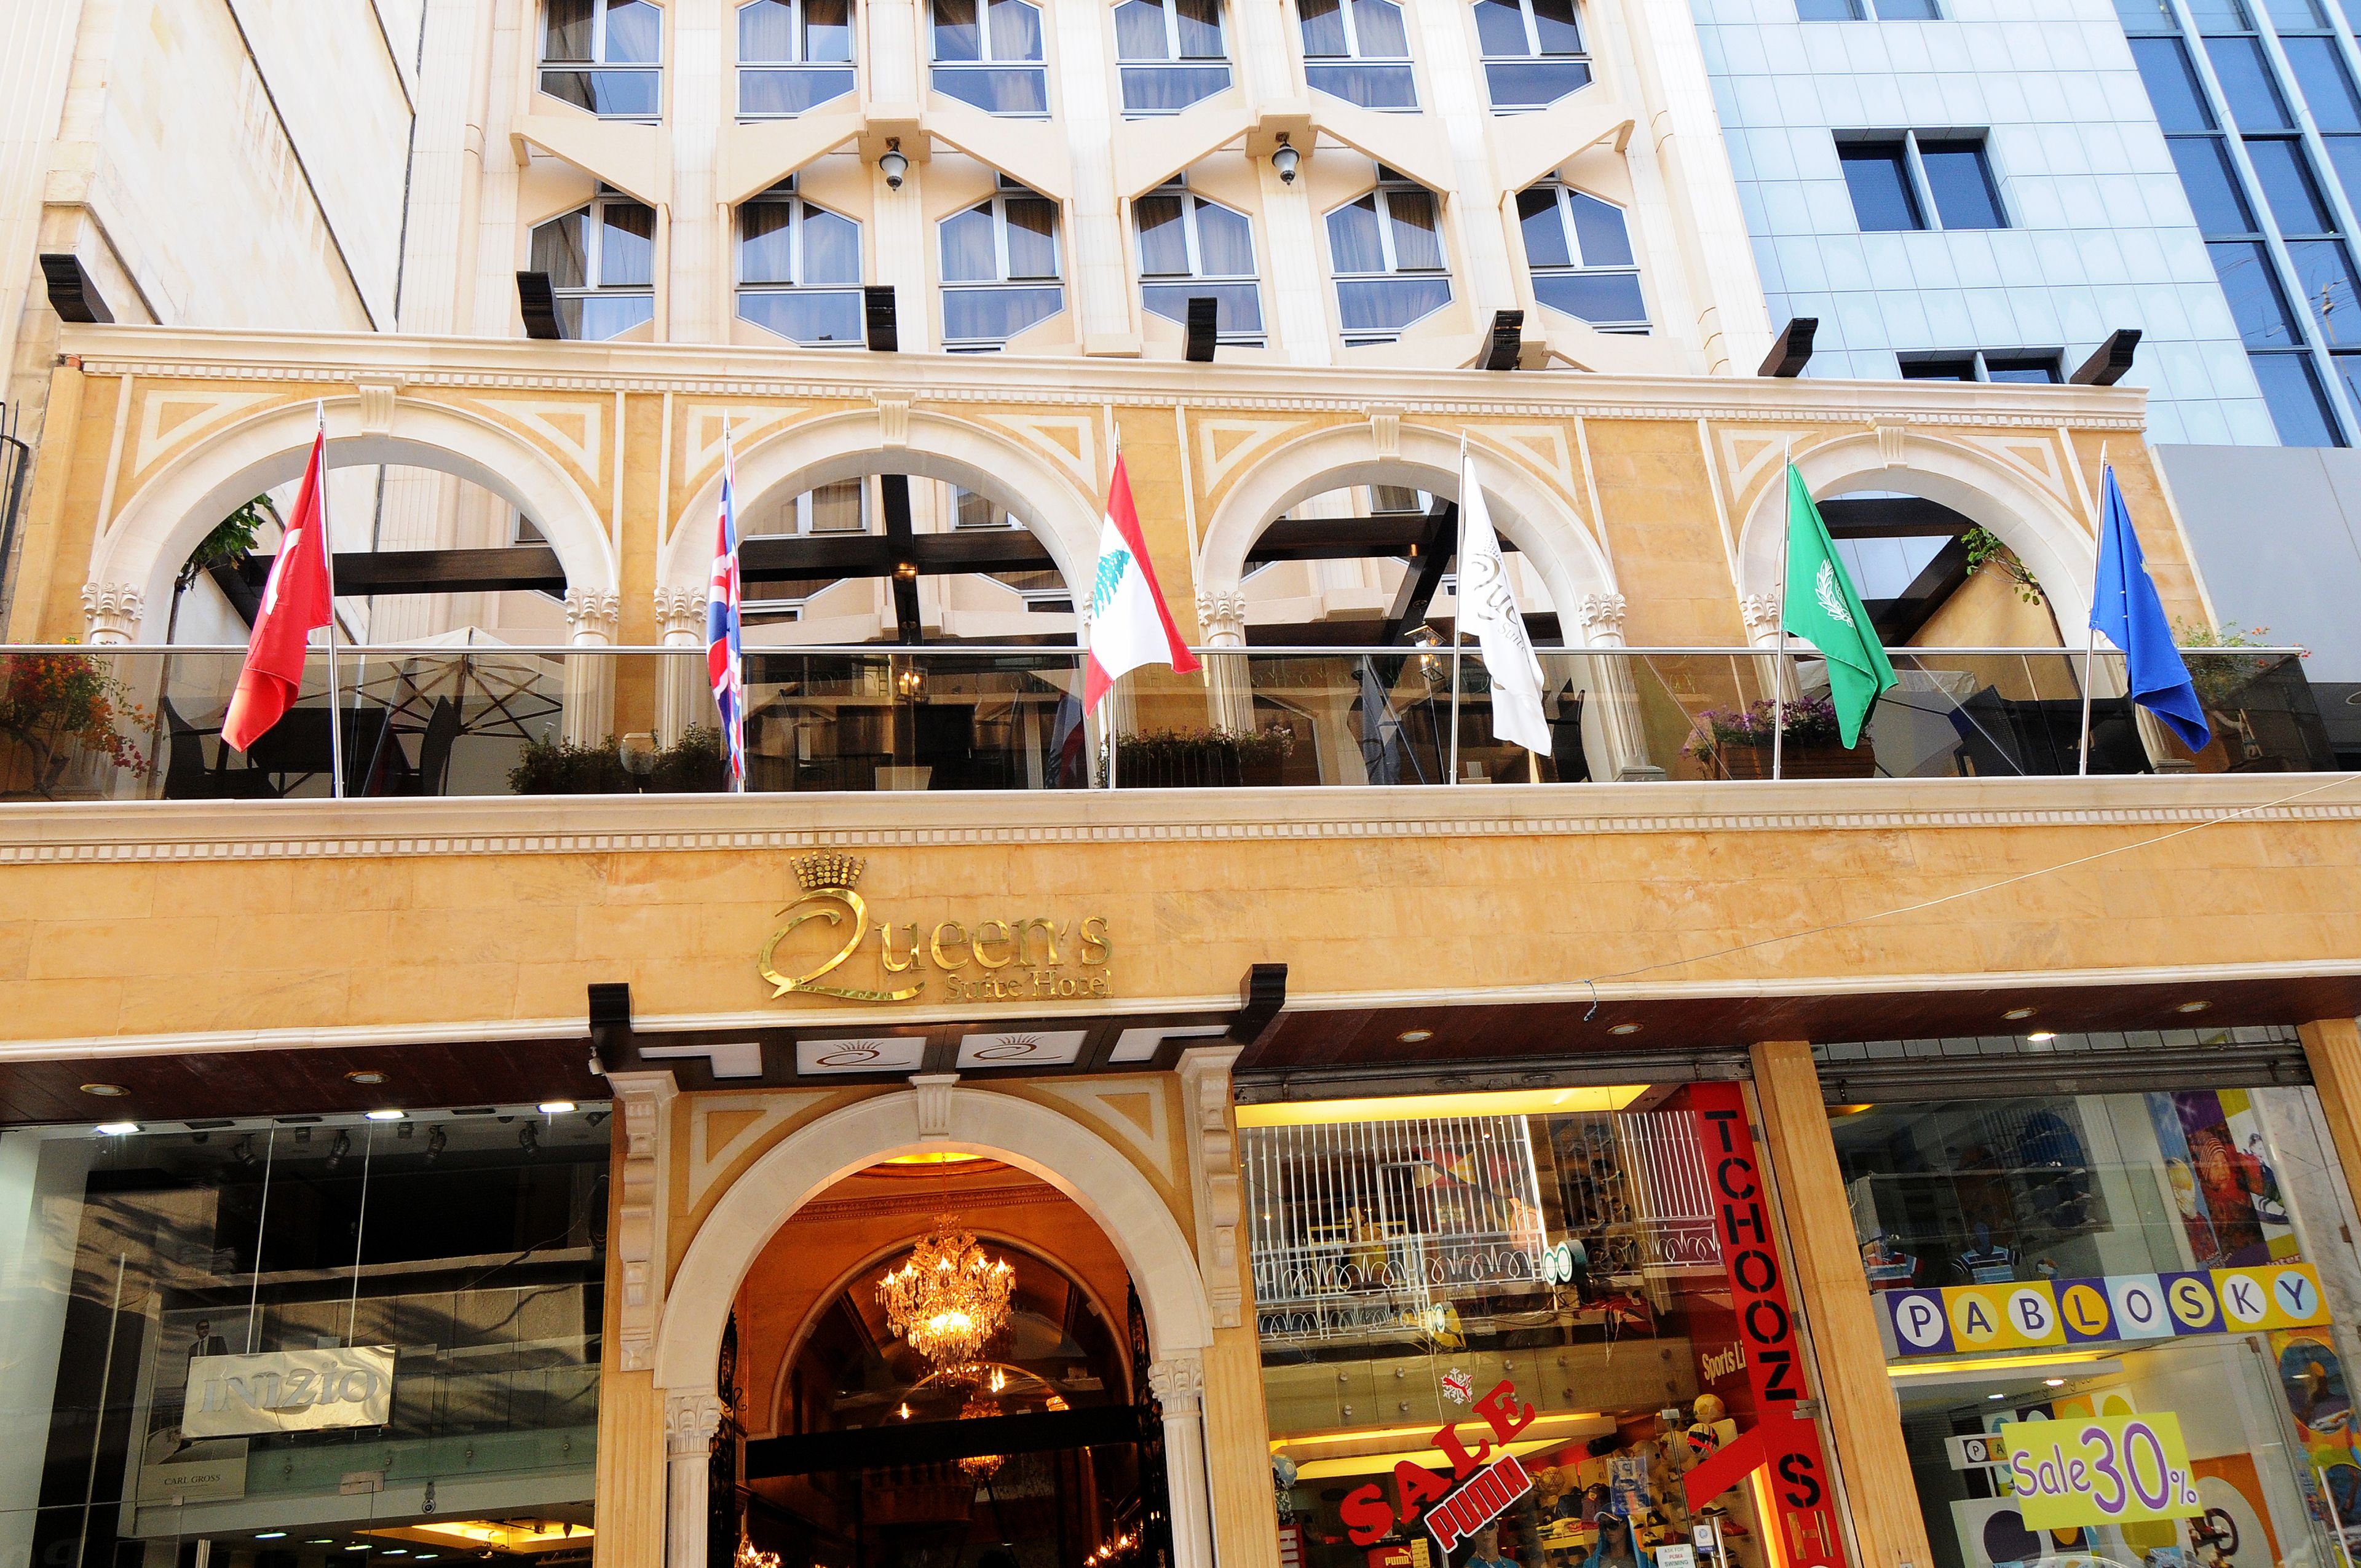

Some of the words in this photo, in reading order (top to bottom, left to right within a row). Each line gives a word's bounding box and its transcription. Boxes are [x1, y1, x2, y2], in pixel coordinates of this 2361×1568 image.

[757, 887, 1113, 1002] Queen's
[944, 972, 1024, 1000] Suite
[1030, 968, 1114, 997] Hotel
[1908, 1278, 2304, 1338] PABLOSKY
[1702, 1346, 1736, 1385] Sports
[1340, 1379, 1536, 1546] SALE
[2012, 1444, 2091, 1496] Sale
[1425, 1453, 1532, 1553] PUMA
